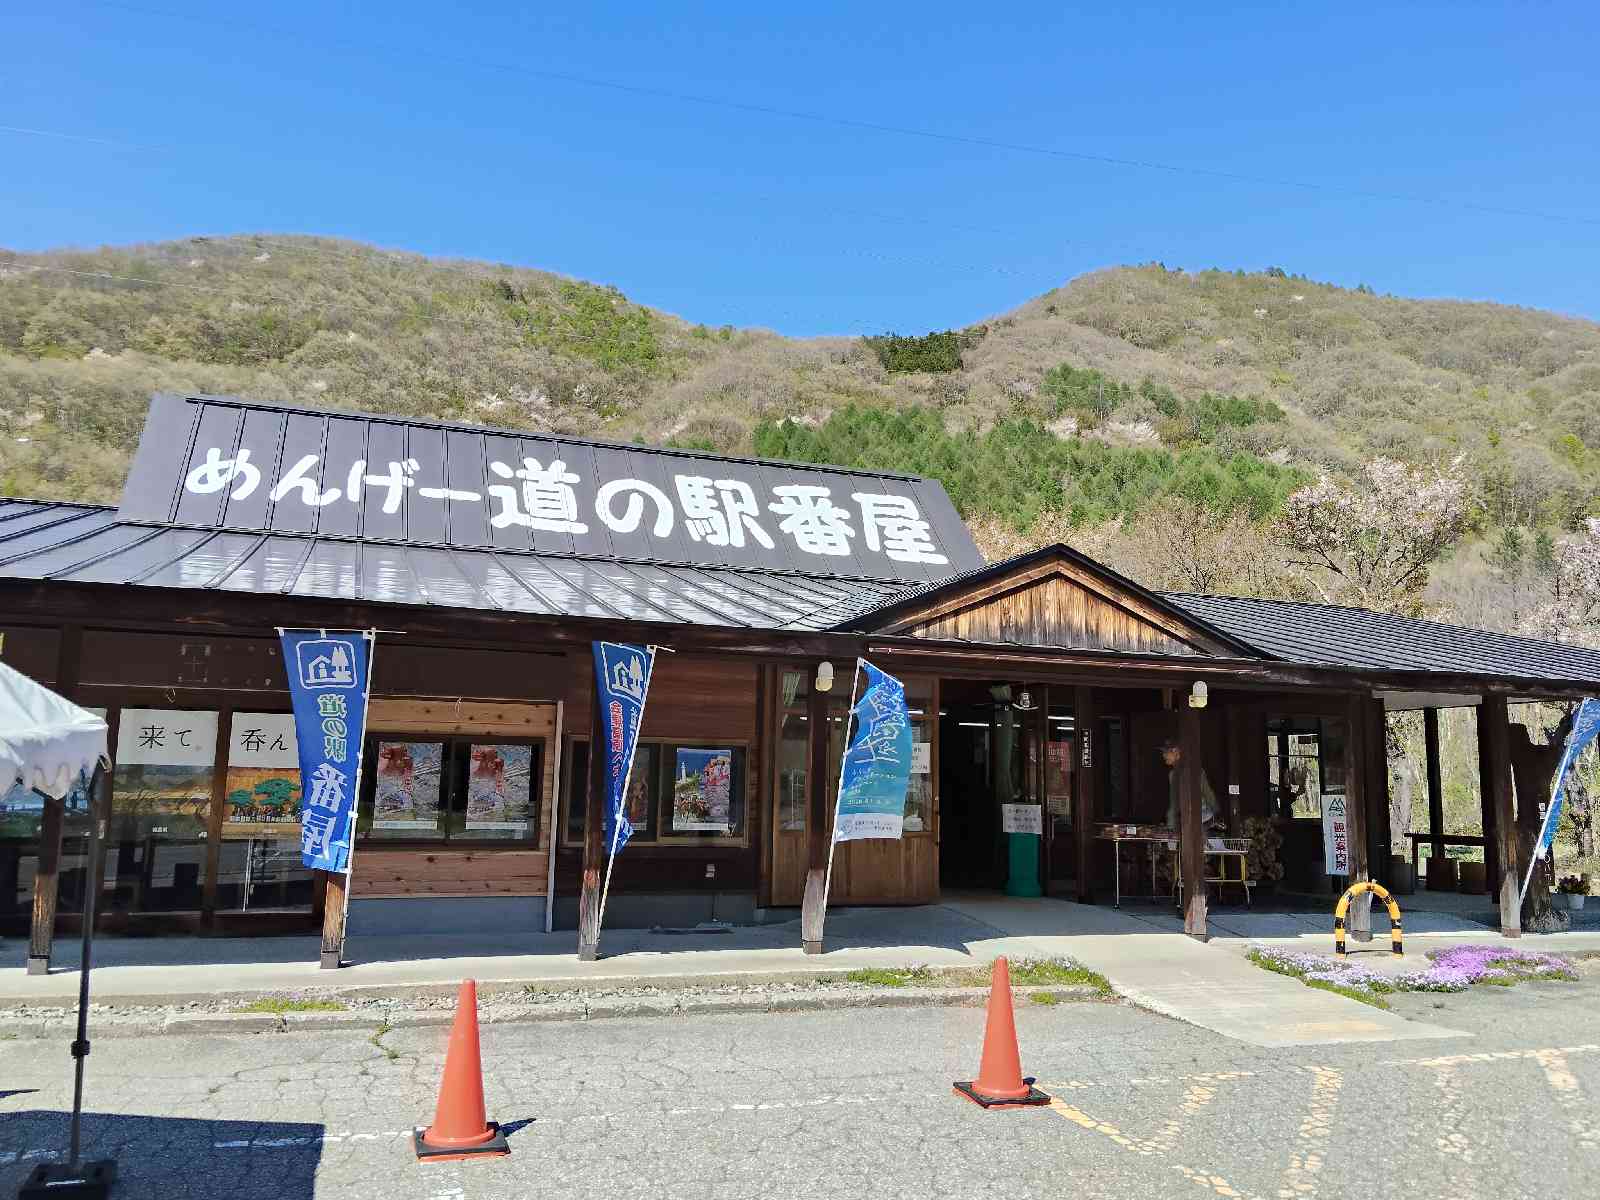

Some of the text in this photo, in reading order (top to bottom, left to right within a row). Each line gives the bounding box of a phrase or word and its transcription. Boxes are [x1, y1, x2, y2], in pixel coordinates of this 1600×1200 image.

[185, 446, 950, 565] めんげー道の駅番屋
[138, 724, 193, 749] 来て
